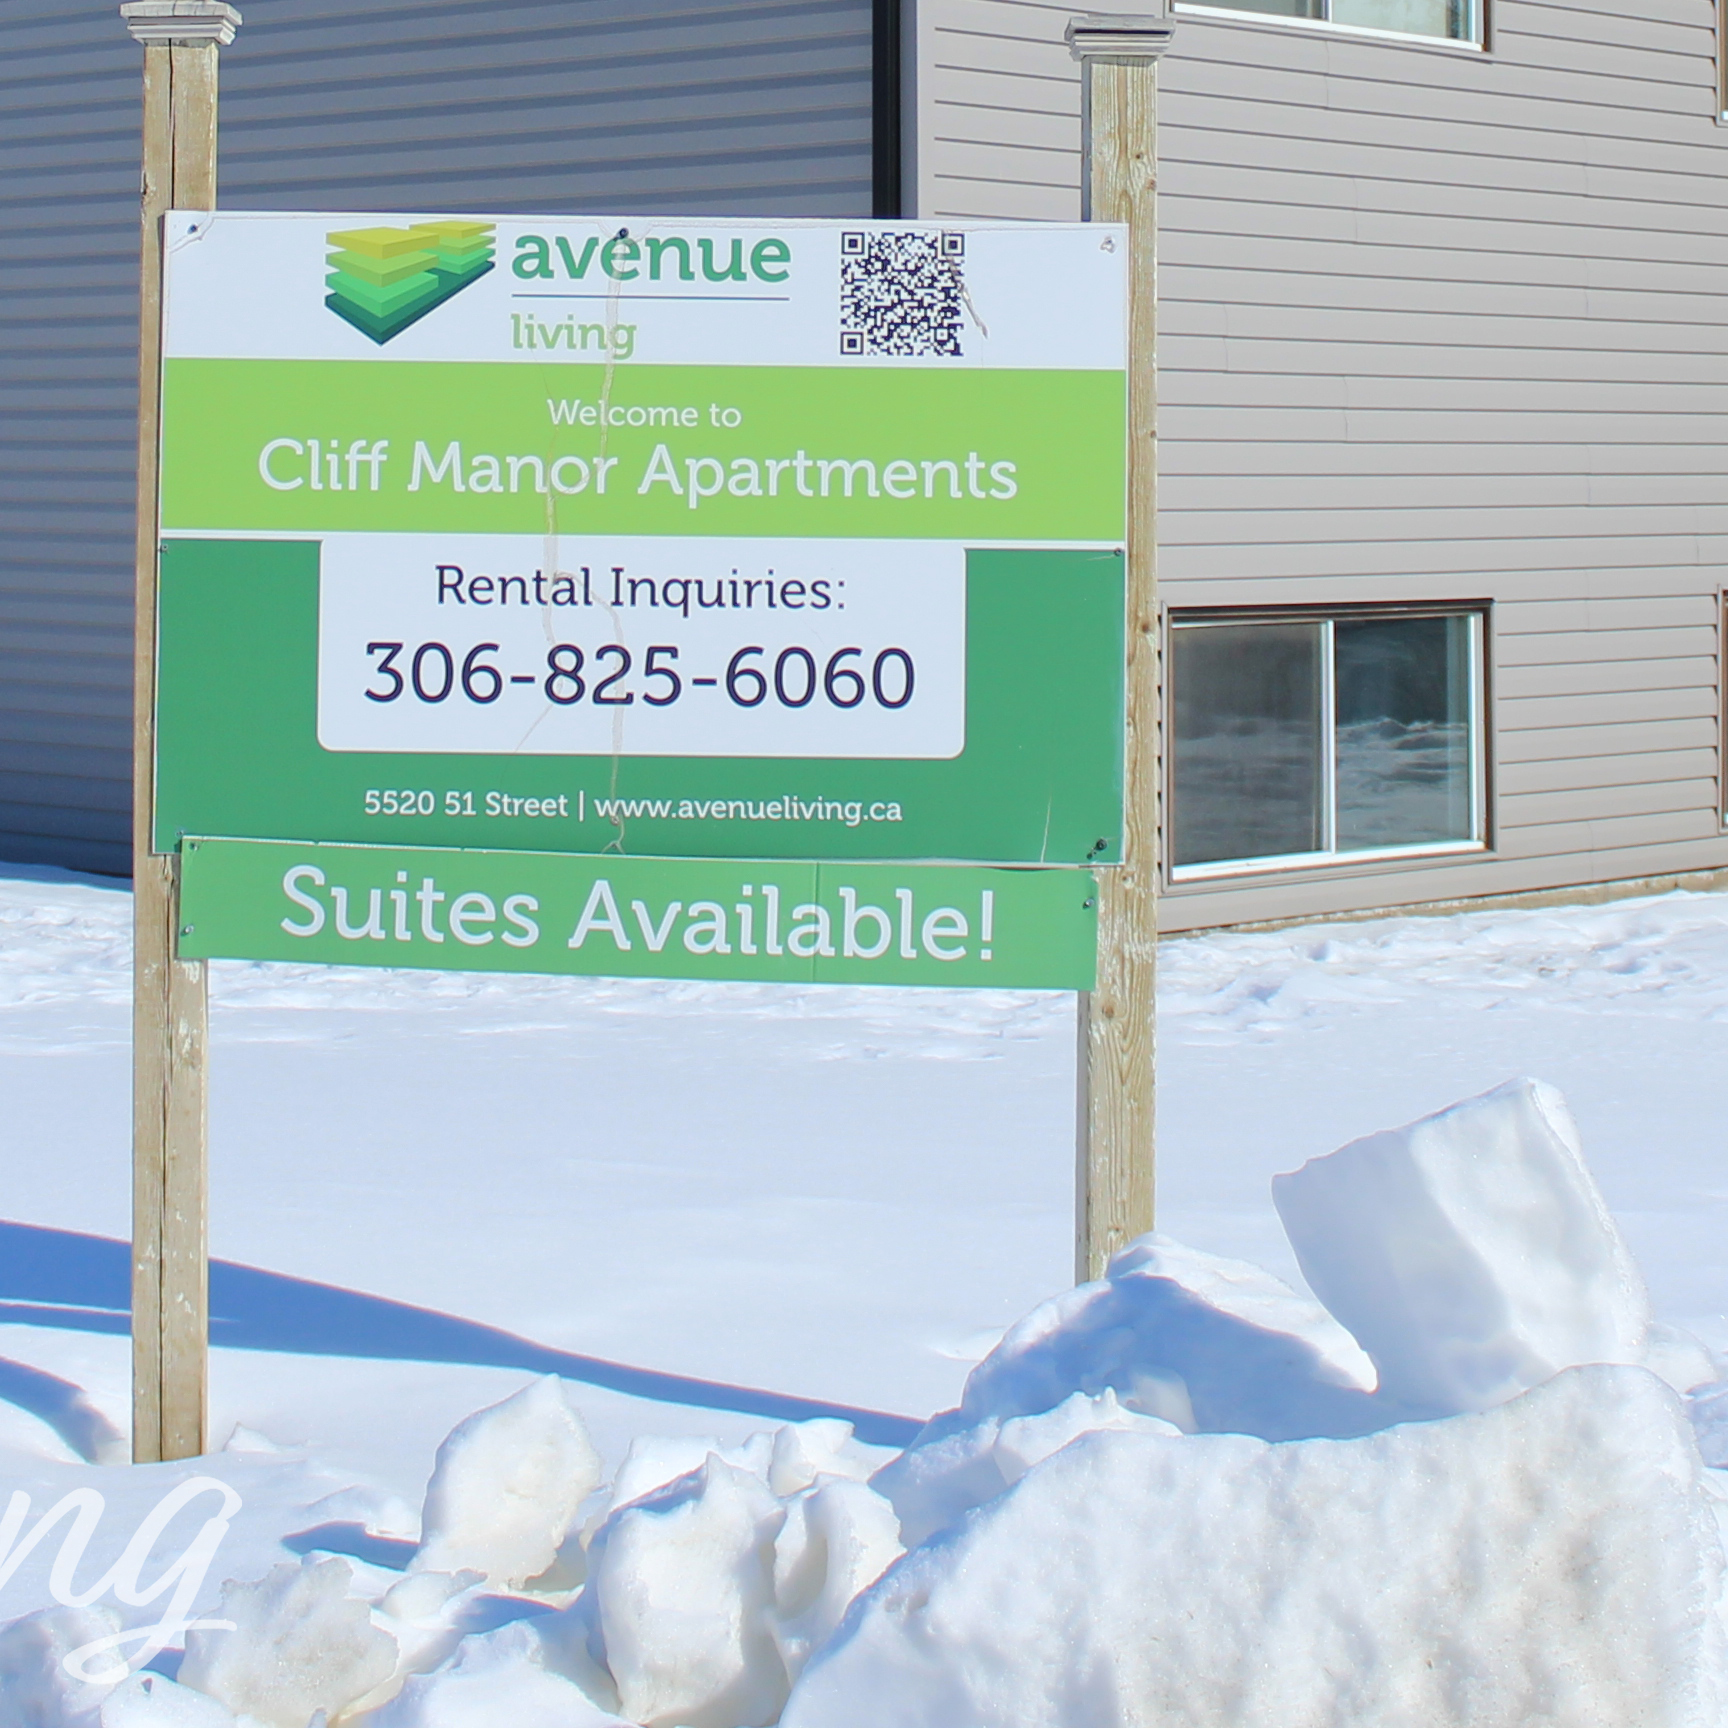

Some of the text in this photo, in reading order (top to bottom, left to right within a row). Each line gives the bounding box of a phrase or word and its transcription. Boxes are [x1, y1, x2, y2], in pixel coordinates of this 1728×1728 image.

[510, 232, 792, 283] avenue
[510, 313, 639, 358] living
[547, 397, 743, 428] Welcome to
[258, 439, 1018, 508] Cliff Manor Apartments
[435, 564, 848, 617] Rental Inquiries:
[362, 641, 917, 709] 306-825-6060
[363, 789, 436, 817] 5520
[443, 790, 478, 817] 51
[484, 790, 570, 818] Street
[594, 794, 903, 827] www.avenueliving.ca
[280, 864, 995, 961] Suites Available!
